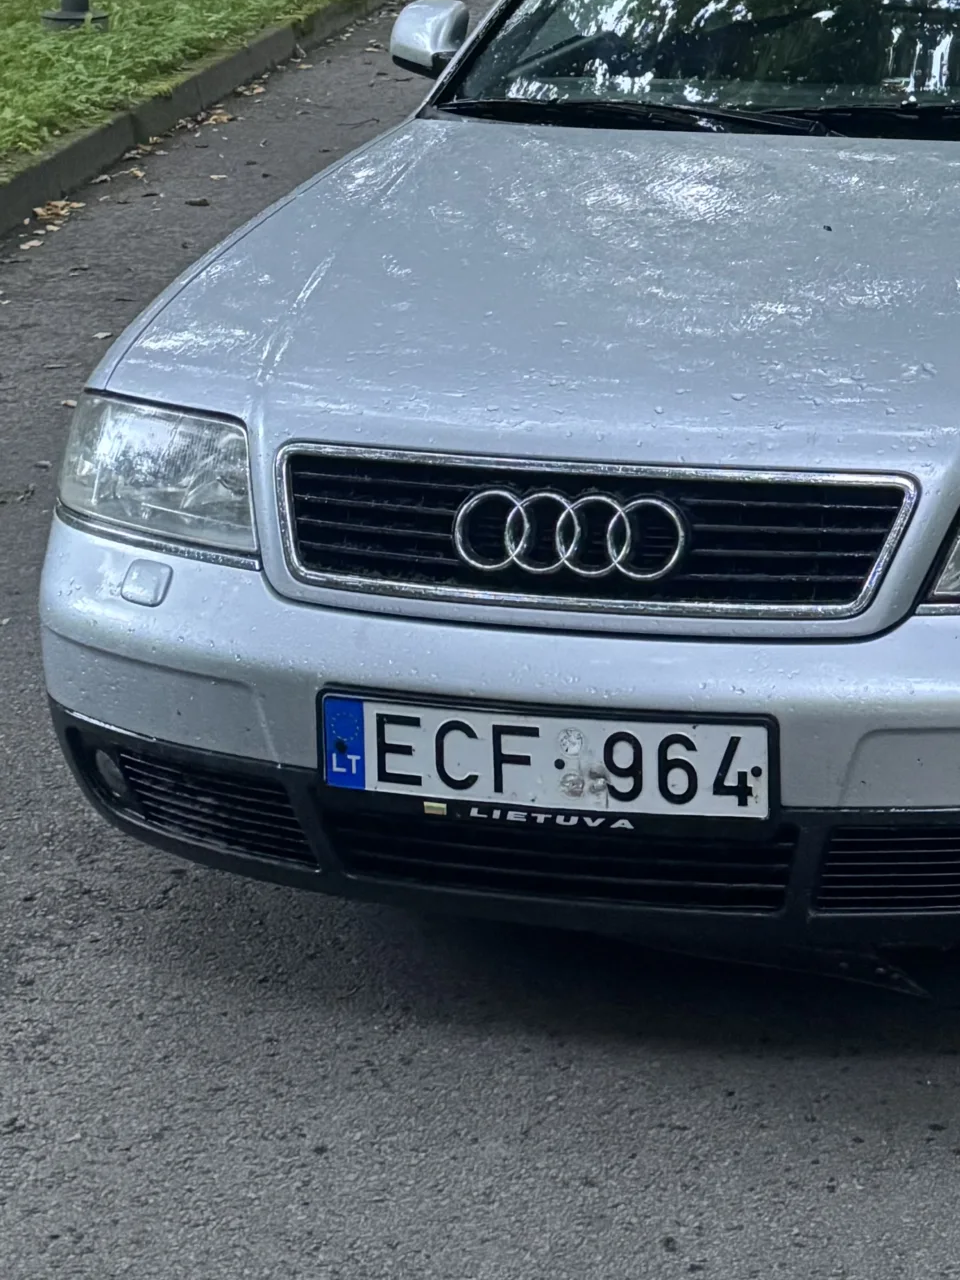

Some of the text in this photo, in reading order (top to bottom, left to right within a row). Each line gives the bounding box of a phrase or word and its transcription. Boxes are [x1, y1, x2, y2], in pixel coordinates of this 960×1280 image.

[332, 753, 361, 774] LT
[376, 713, 753, 807] ECF 964
[469, 807, 634, 830] LIETUVA
